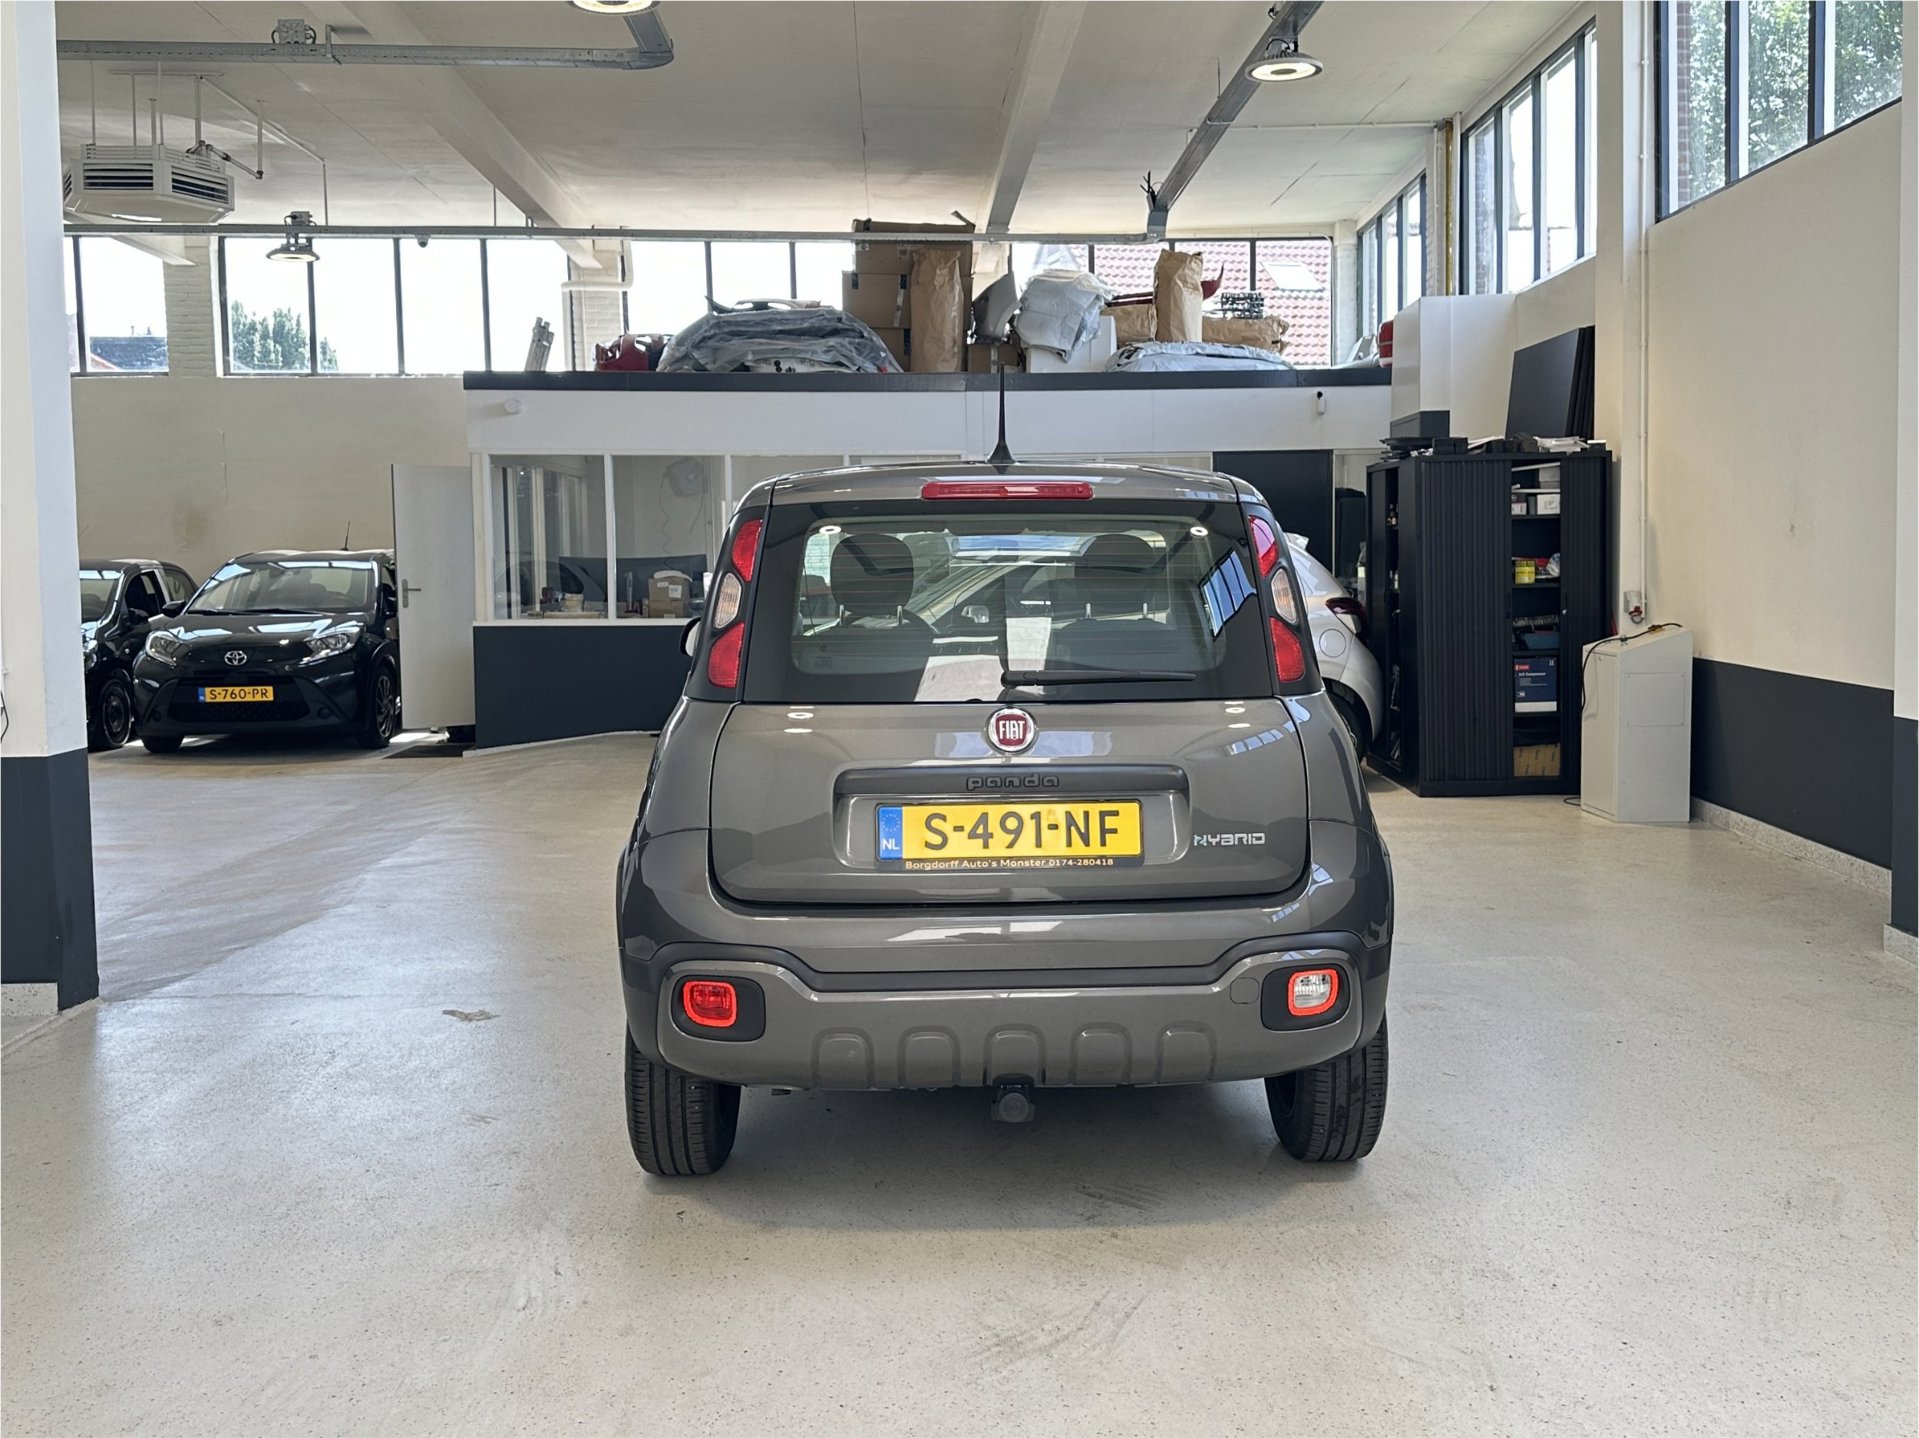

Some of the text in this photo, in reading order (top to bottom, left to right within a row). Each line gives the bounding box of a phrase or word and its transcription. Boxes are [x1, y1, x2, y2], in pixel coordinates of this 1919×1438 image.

[209, 688, 269, 700] S-760-PR
[998, 720, 1026, 740] FIAT
[966, 773, 1060, 791] panda
[924, 810, 1120, 851] S-491-NF
[882, 838, 900, 851] NL
[1193, 832, 1266, 847] HYBRID
[905, 858, 1114, 870] Borgdorff Auto's Monster 0174-280418
